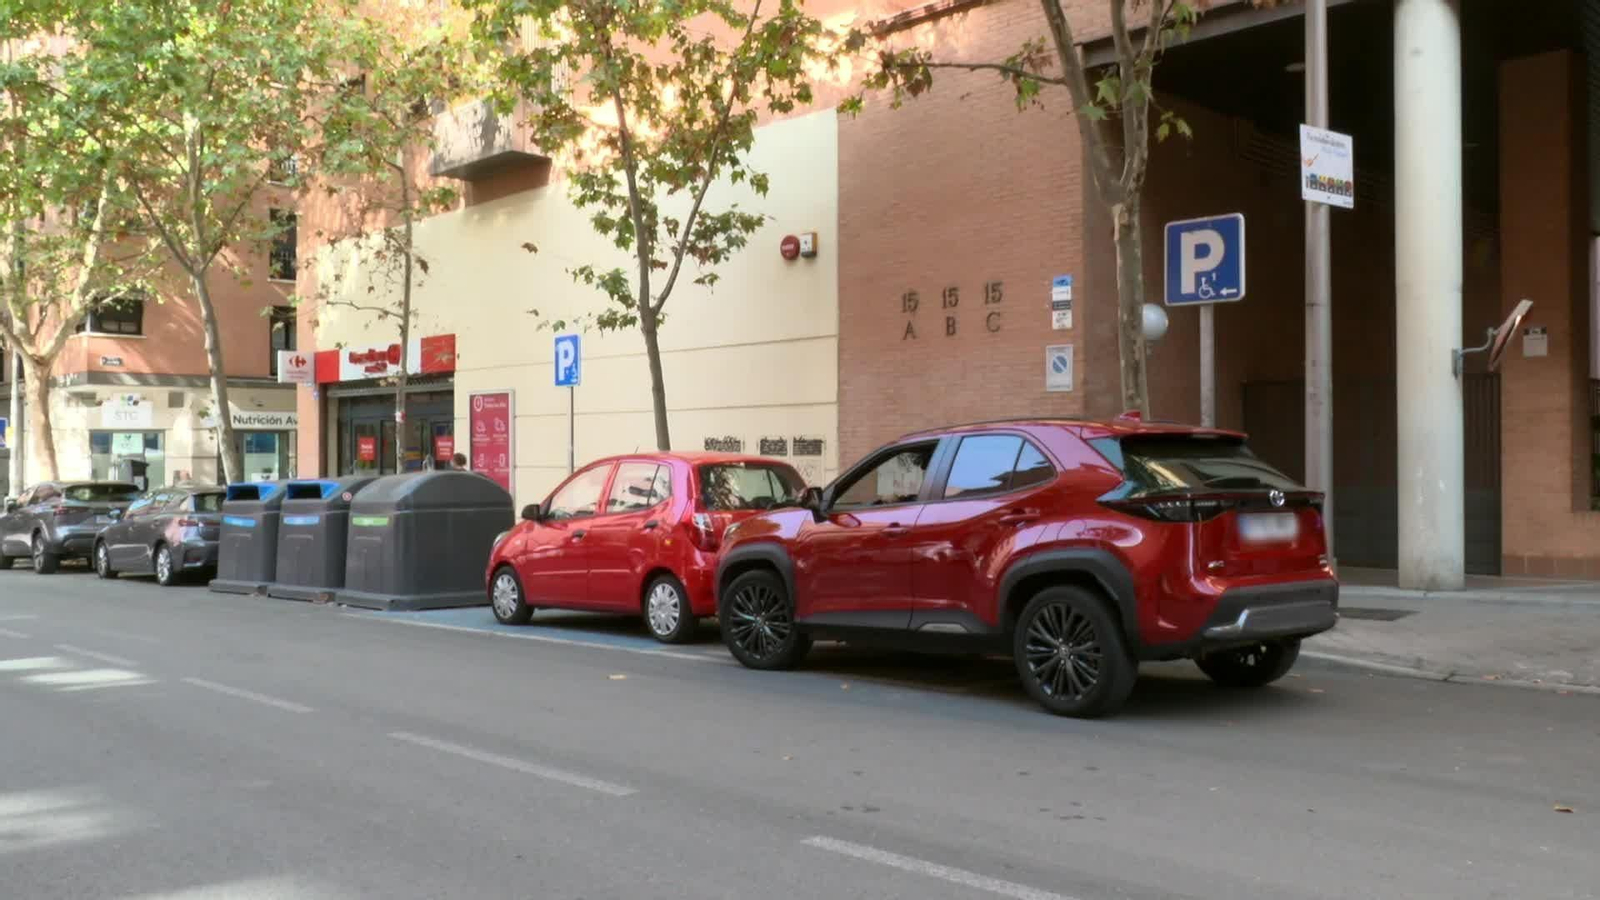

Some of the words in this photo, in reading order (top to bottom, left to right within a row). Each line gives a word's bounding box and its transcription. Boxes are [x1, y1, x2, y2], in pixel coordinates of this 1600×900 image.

[1181, 229, 1225, 294] P
[902, 292, 919, 313] 15
[942, 286, 959, 309] 15
[985, 281, 1003, 304] 15
[903, 320, 917, 341] A
[946, 316, 956, 337] B
[986, 312, 1001, 332] C
[558, 339, 575, 381] P
[233, 414, 283, 425] Nutrición
